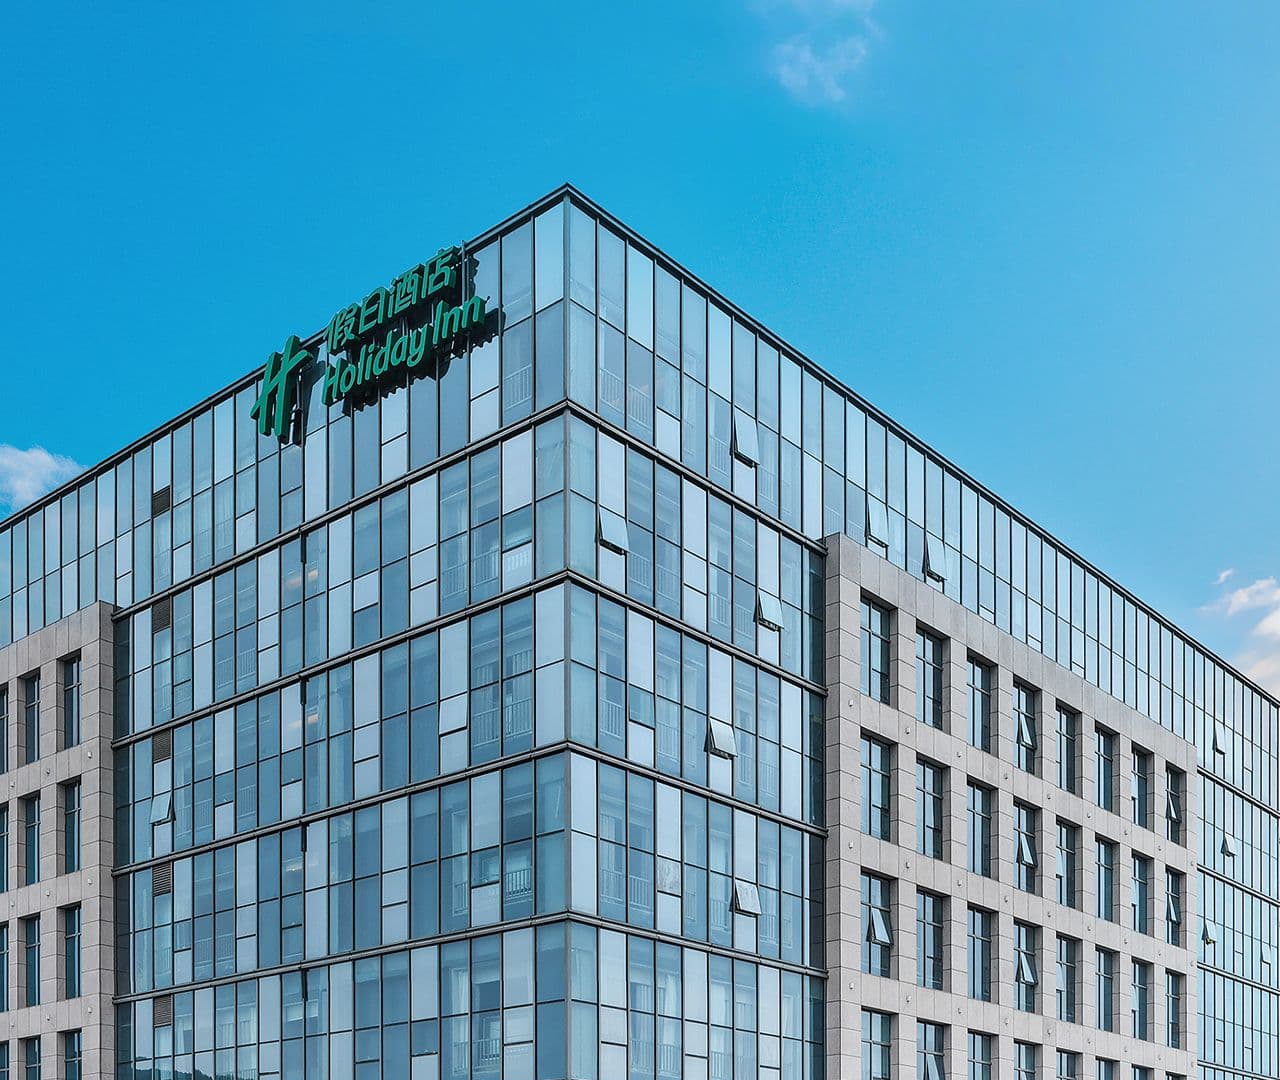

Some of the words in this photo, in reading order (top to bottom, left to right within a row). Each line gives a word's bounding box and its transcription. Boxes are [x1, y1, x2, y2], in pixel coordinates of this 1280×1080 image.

[322, 324, 432, 405] Holiday
[433, 296, 486, 344] Inn
[323, 246, 462, 353] 假日酒店
